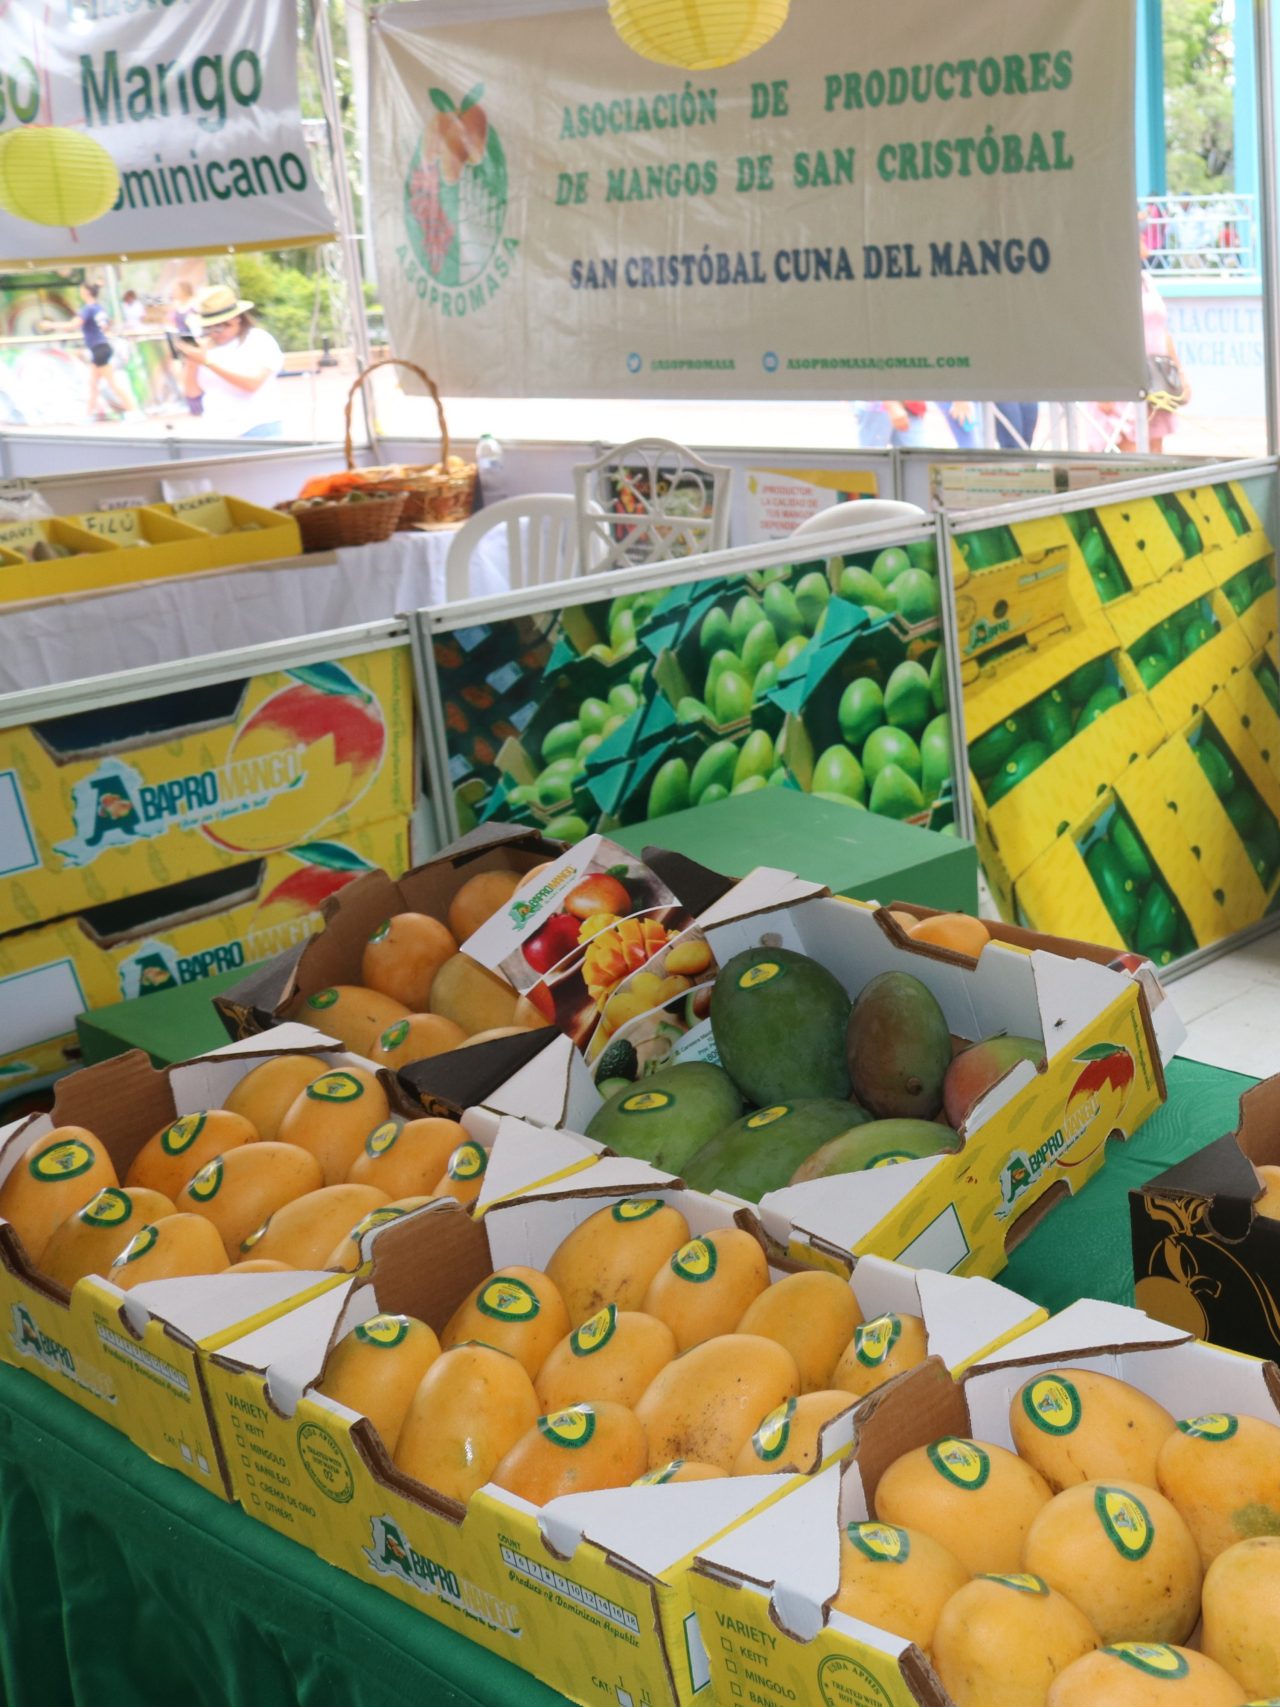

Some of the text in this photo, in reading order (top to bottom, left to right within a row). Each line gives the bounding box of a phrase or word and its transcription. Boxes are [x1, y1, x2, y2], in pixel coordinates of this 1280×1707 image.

[80, 49, 262, 133] Mango
[559, 50, 1073, 141] ASOCIACIÓN DE PRODUCTORES
[111, 151, 308, 211] minicano
[555, 124, 1074, 206] DE MANGOS DE SAN CRISTÓBAL
[569, 237, 1050, 290] SAN CRISTÓBAL CUNA DEL MANGO
[225, 1392, 268, 1424] VARIETY
[555, 1596, 601, 1627] Dominican
[604, 1622, 639, 1648] Republic
[715, 1610, 777, 1650] VARIETY
[740, 1645, 769, 1667] KEITT
[744, 1669, 797, 1701] MINGOLO
